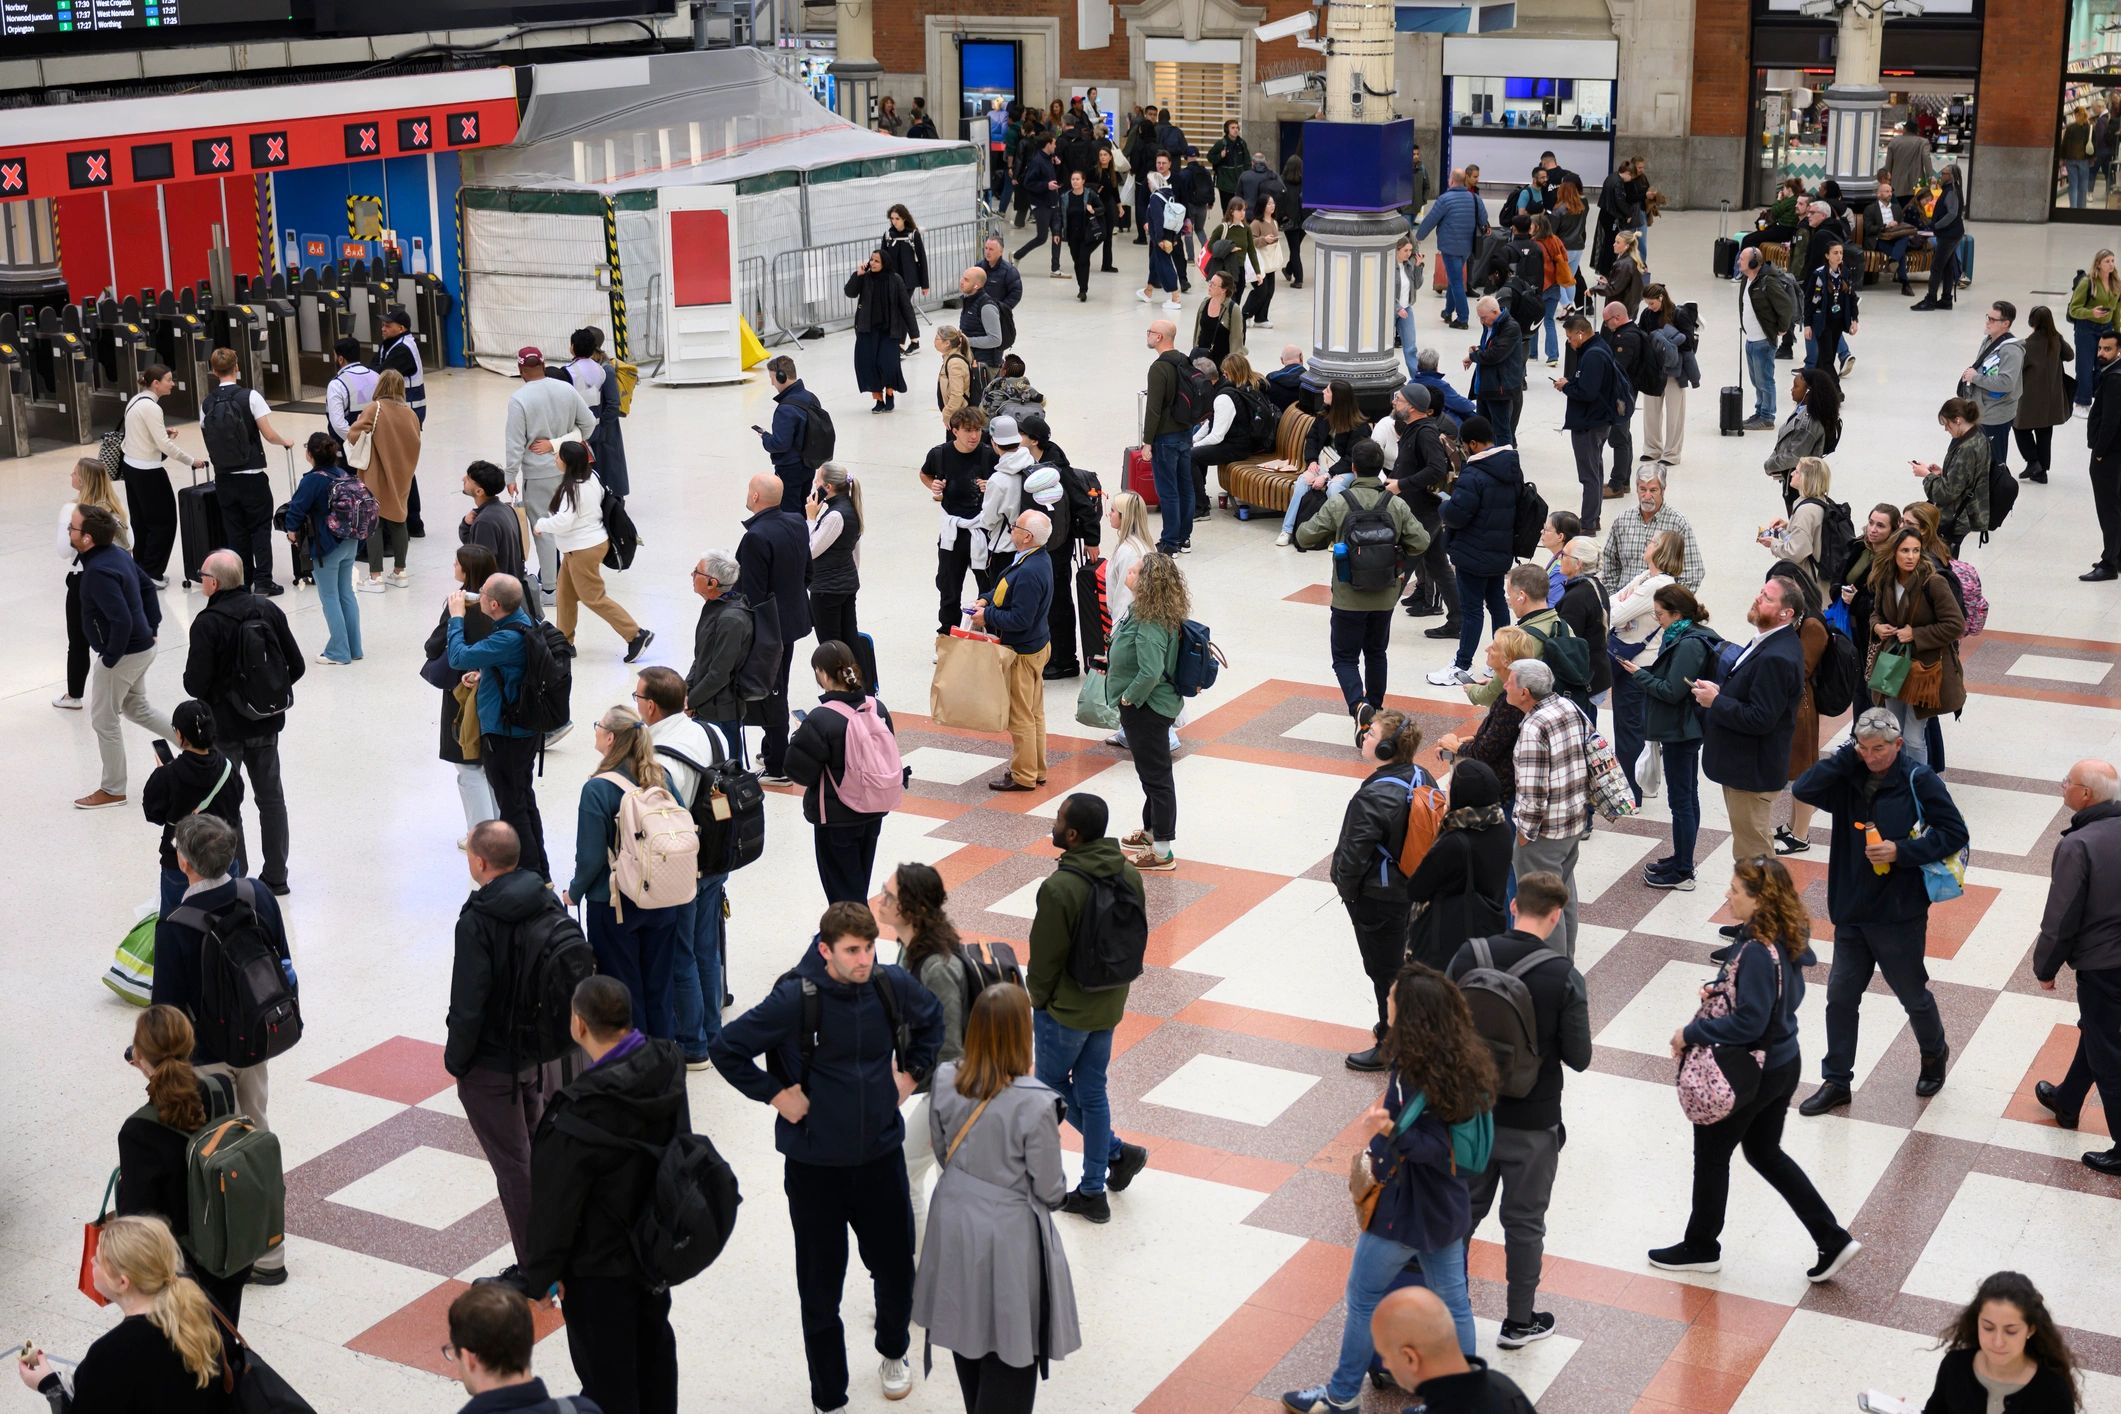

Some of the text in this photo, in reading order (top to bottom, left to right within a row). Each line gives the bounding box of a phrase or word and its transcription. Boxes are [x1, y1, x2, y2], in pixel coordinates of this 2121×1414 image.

[5, 4, 28, 12] Norbury
[6, 14, 31, 22] Norwood
[32, 13, 53, 22] Junction
[8, 26, 34, 34] Orpington
